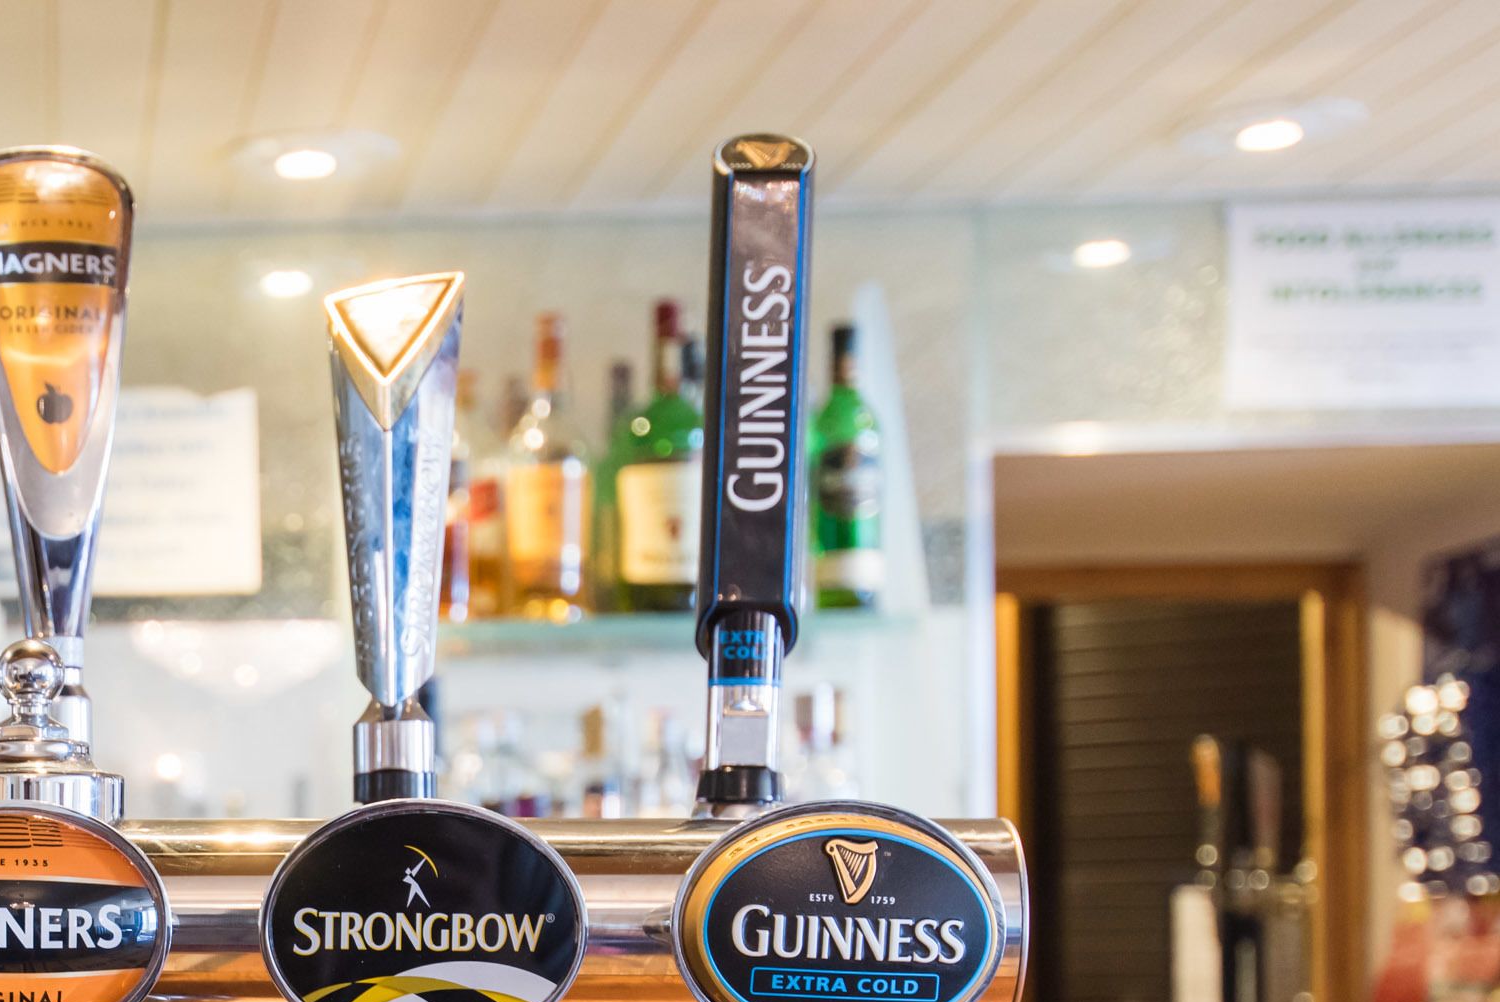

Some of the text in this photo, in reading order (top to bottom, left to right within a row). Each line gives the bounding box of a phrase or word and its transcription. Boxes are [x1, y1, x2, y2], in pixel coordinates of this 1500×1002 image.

[727, 264, 792, 513] GUINNESS
[15, 859, 49, 867] 1935
[871, 896, 896, 905] 1759
[731, 904, 966, 964] GUINNESS
[771, 974, 919, 996] EXTRA COLD
